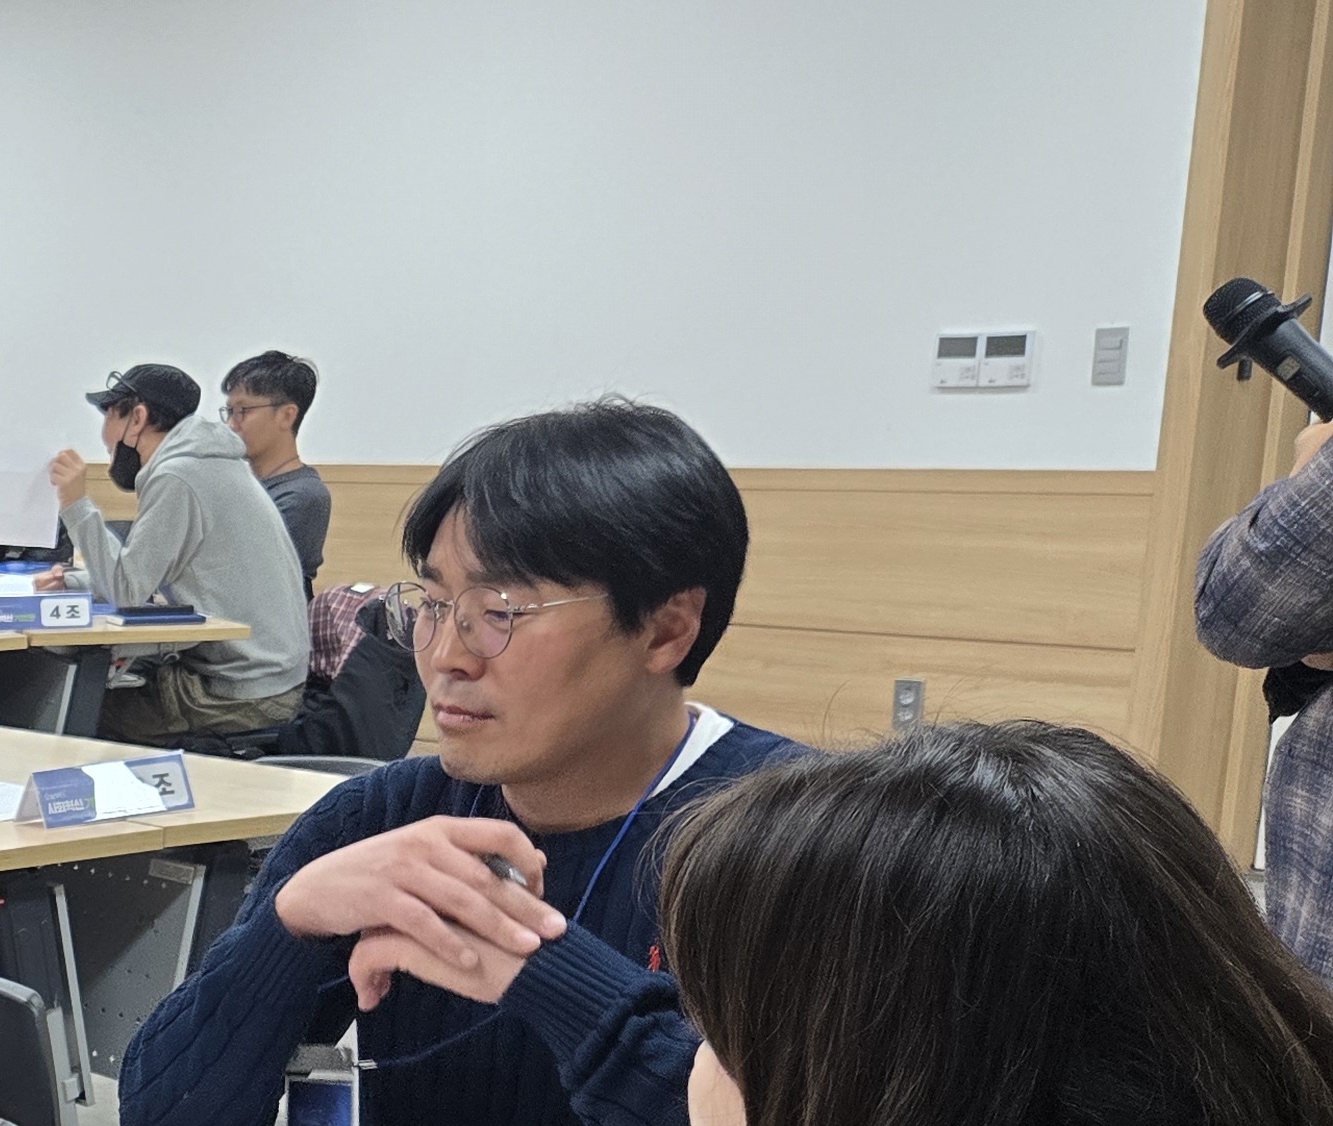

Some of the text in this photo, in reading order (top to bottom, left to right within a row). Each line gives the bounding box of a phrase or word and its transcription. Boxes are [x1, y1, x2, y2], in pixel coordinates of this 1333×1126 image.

[49, 605, 61, 619] 4
[65, 604, 81, 619] 조
[151, 772, 175, 796] 조
